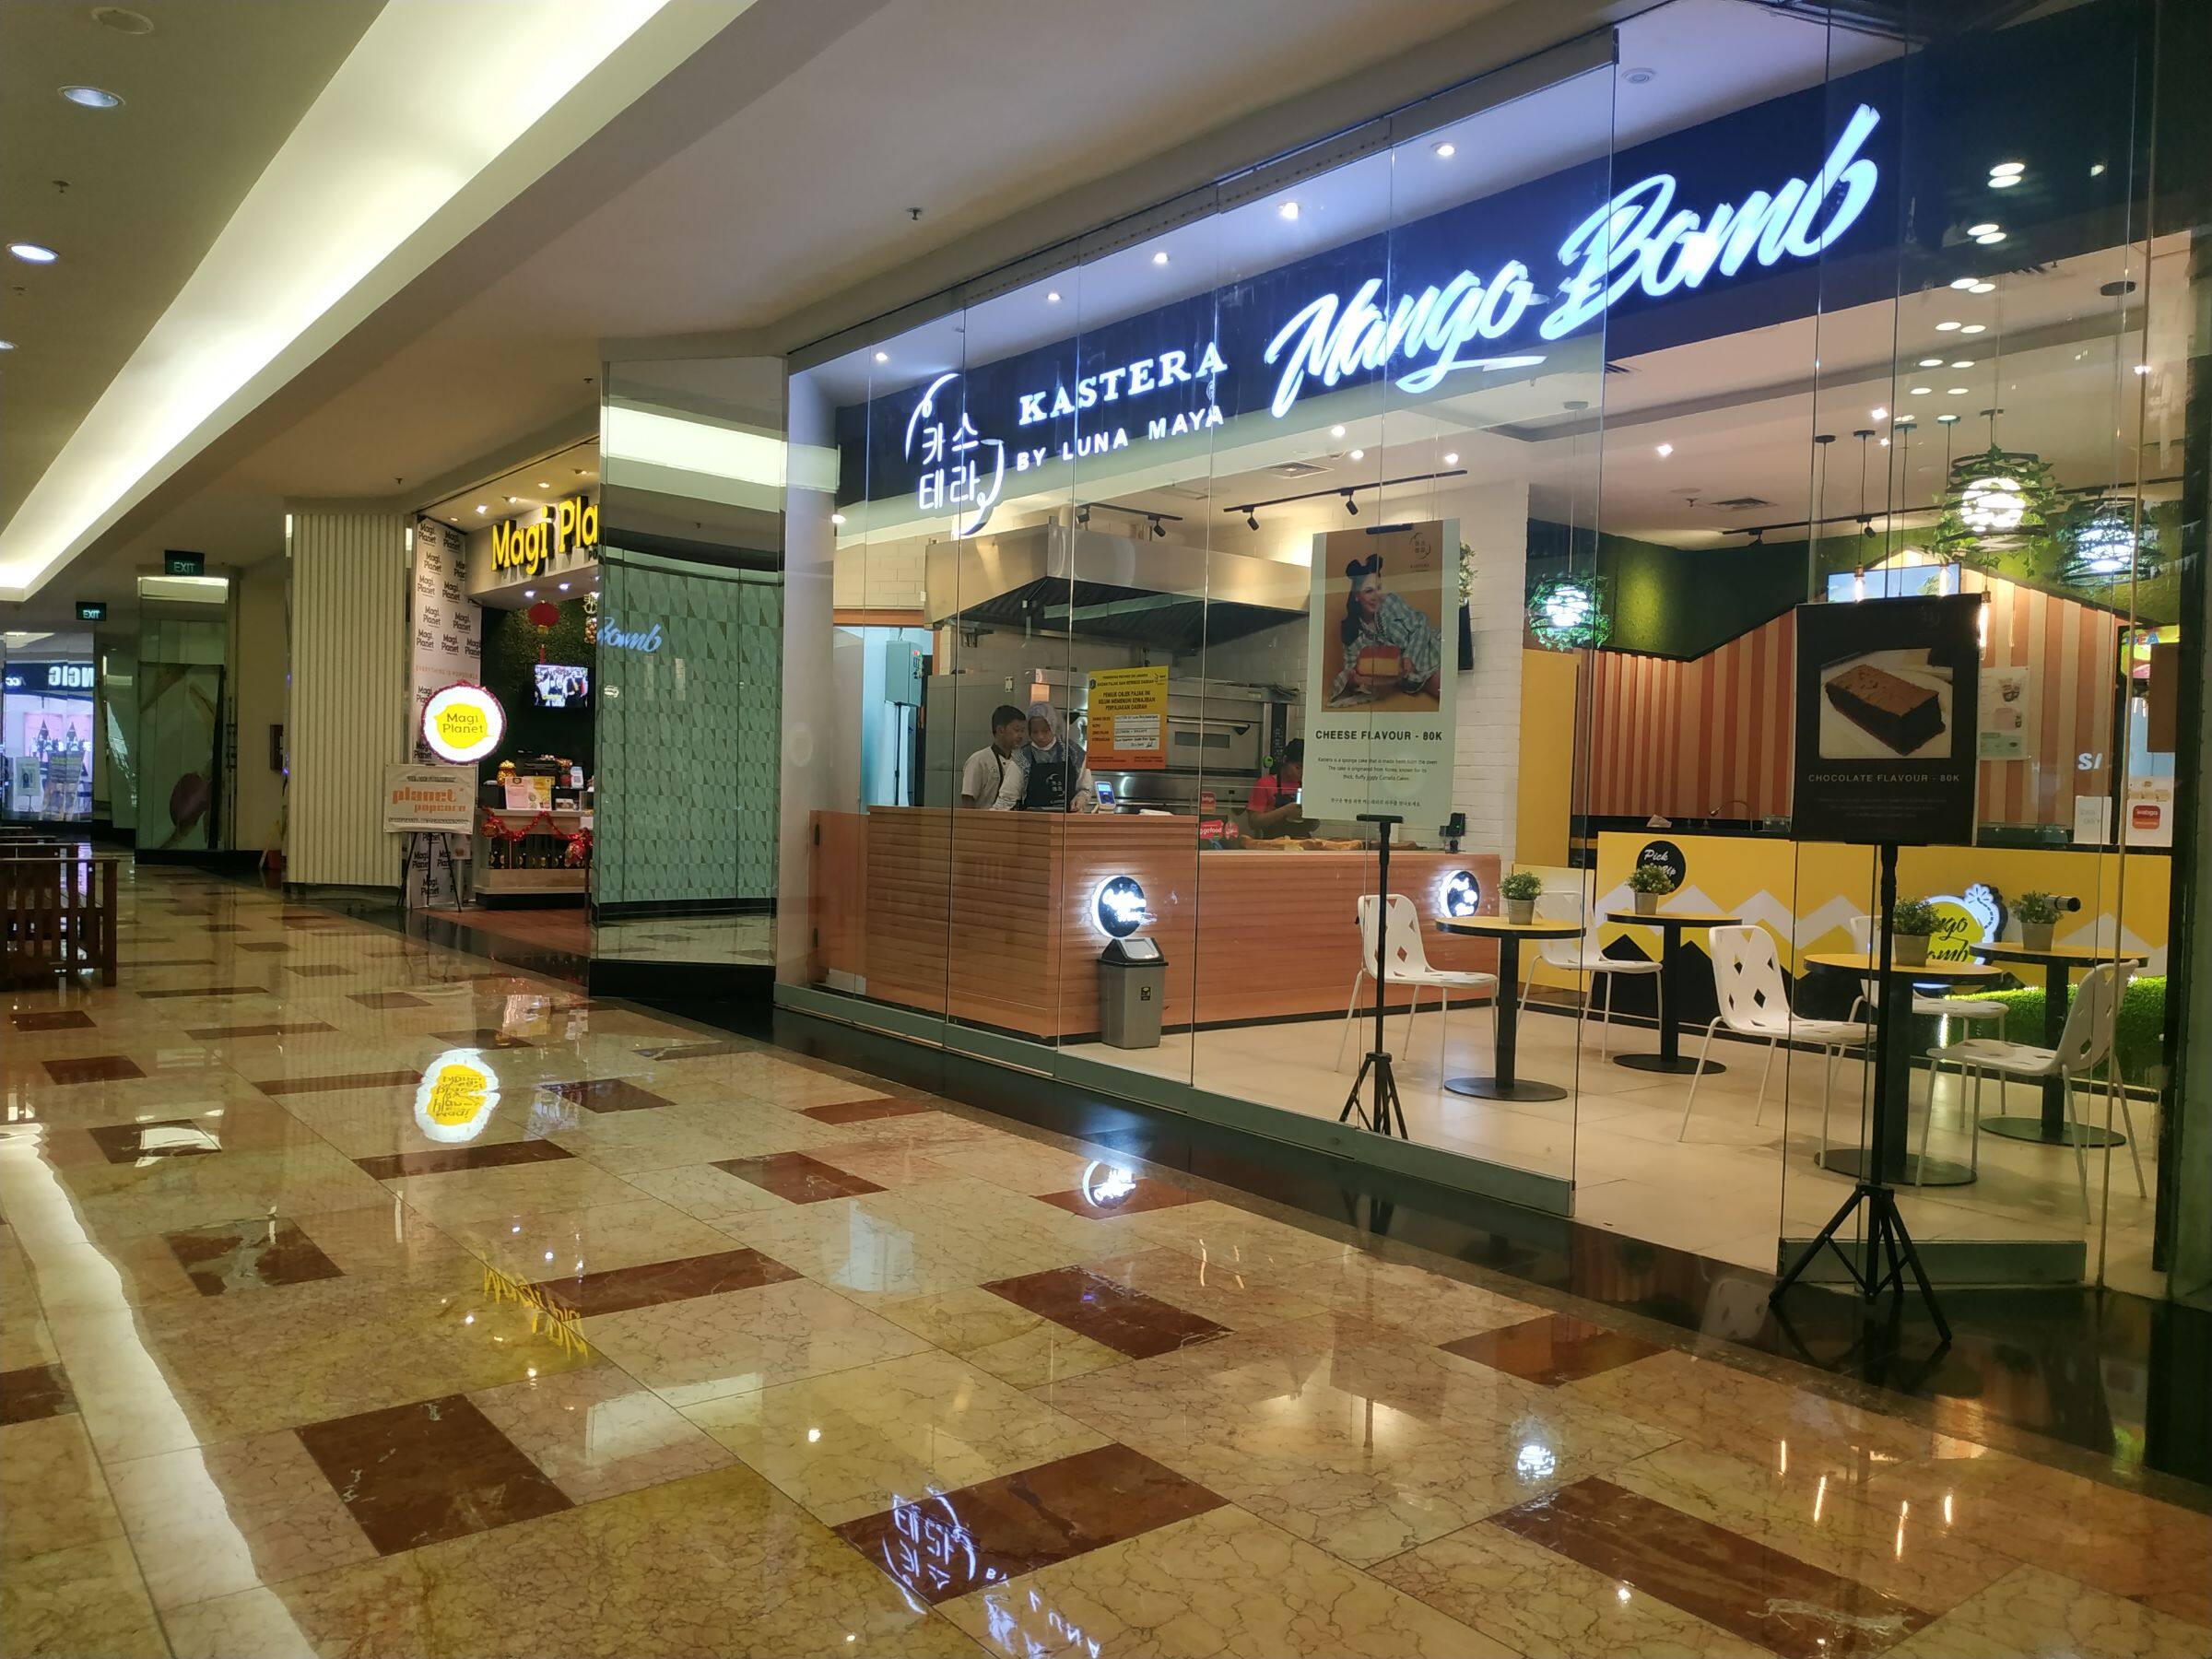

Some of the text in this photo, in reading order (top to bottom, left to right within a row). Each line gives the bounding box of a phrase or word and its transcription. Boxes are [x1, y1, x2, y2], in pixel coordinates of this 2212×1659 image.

[1264, 102, 1881, 419] Mango Bomb
[1018, 342, 1229, 426] KASTERA
[1017, 405, 1224, 472] BY LUNA MAYA
[491, 496, 598, 575] Magi Pla
[174, 561, 195, 573] EXIT
[83, 609, 100, 618] EXIT
[465, 645, 480, 656] Plane
[446, 713, 478, 724] Magi
[442, 724, 484, 734] Planet
[1315, 730, 1358, 740] CHEESE
[1361, 730, 1411, 741] FLAVOUR
[1422, 731, 1442, 741] 80K
[1808, 774, 1873, 782] CHOCOLATE
[1877, 774, 1928, 782] FLAVOUR
[1940, 774, 1960, 782] 80K
[1644, 849, 1669, 861] Pick
[412, 859, 429, 869] Plane
